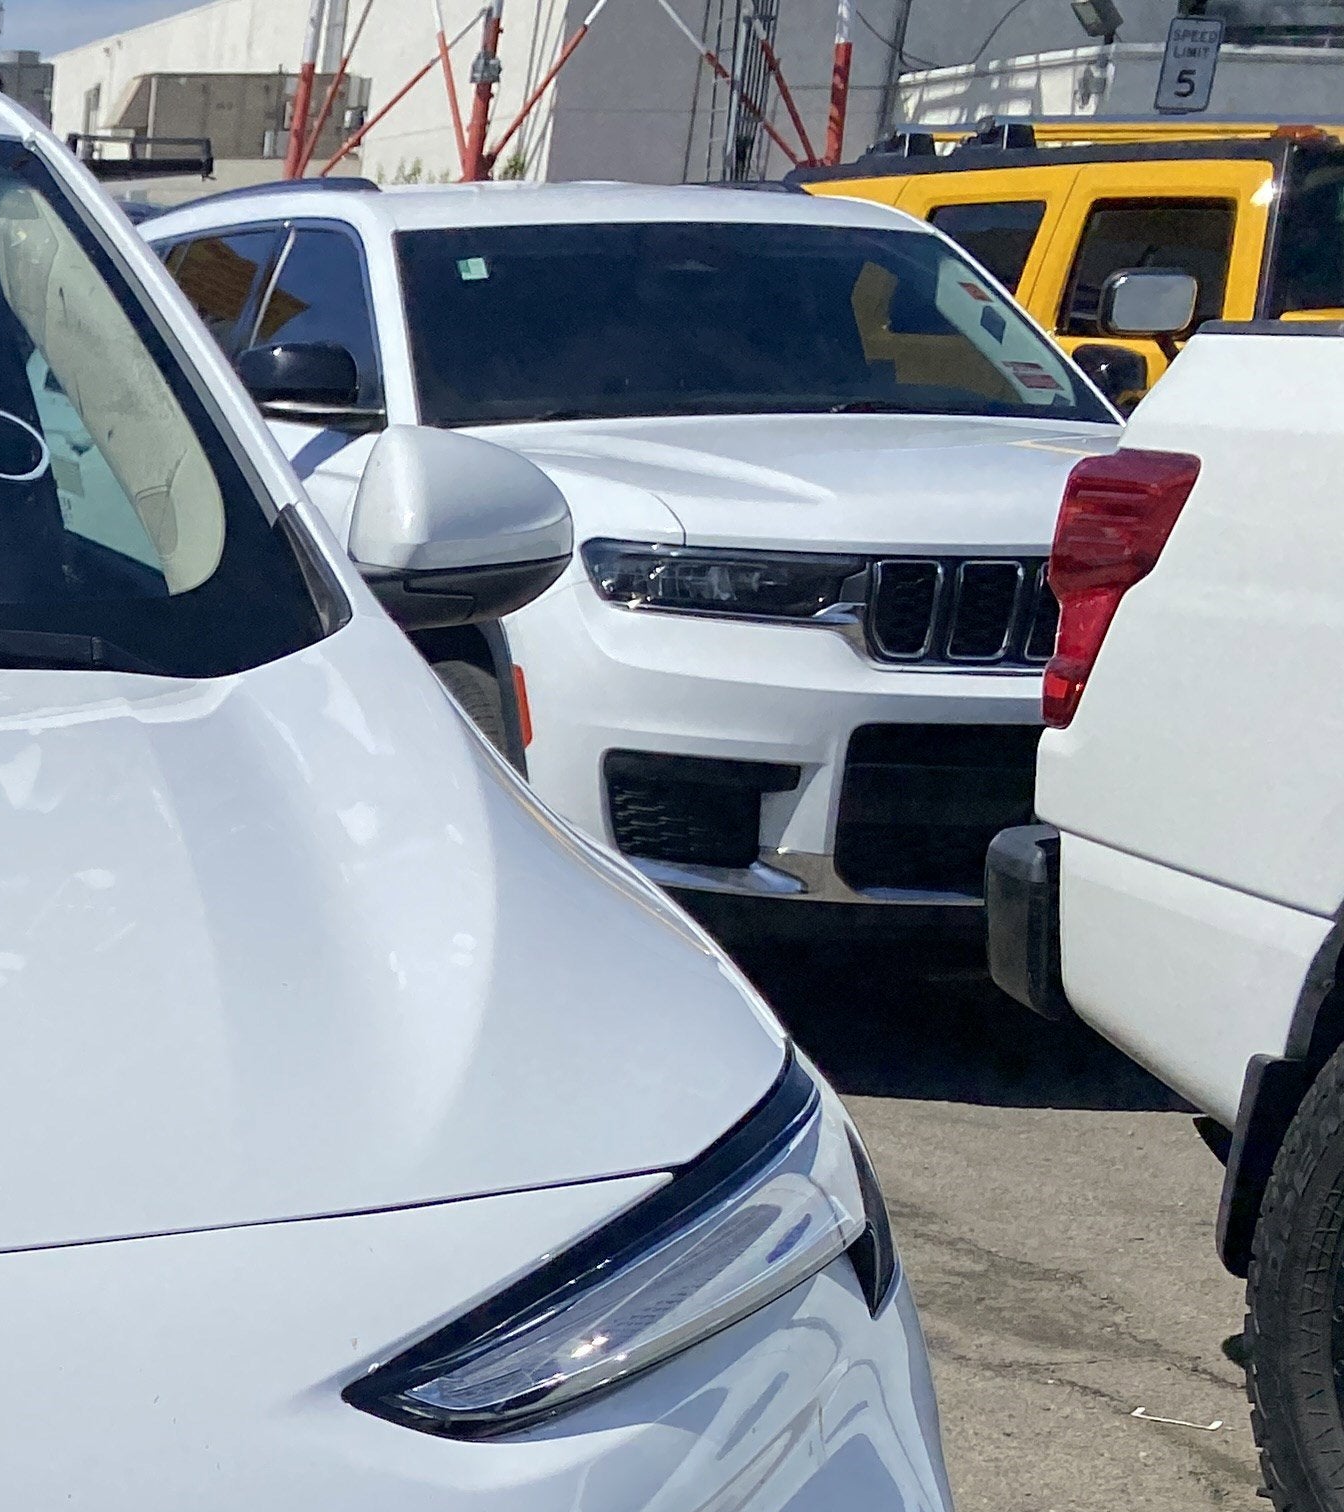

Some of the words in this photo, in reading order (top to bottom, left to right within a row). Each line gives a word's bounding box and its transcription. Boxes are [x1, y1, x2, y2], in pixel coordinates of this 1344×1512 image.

[1173, 29, 1216, 43] SPEED
[1173, 46, 1209, 58] LIMIT
[1174, 69, 1196, 97] 5
